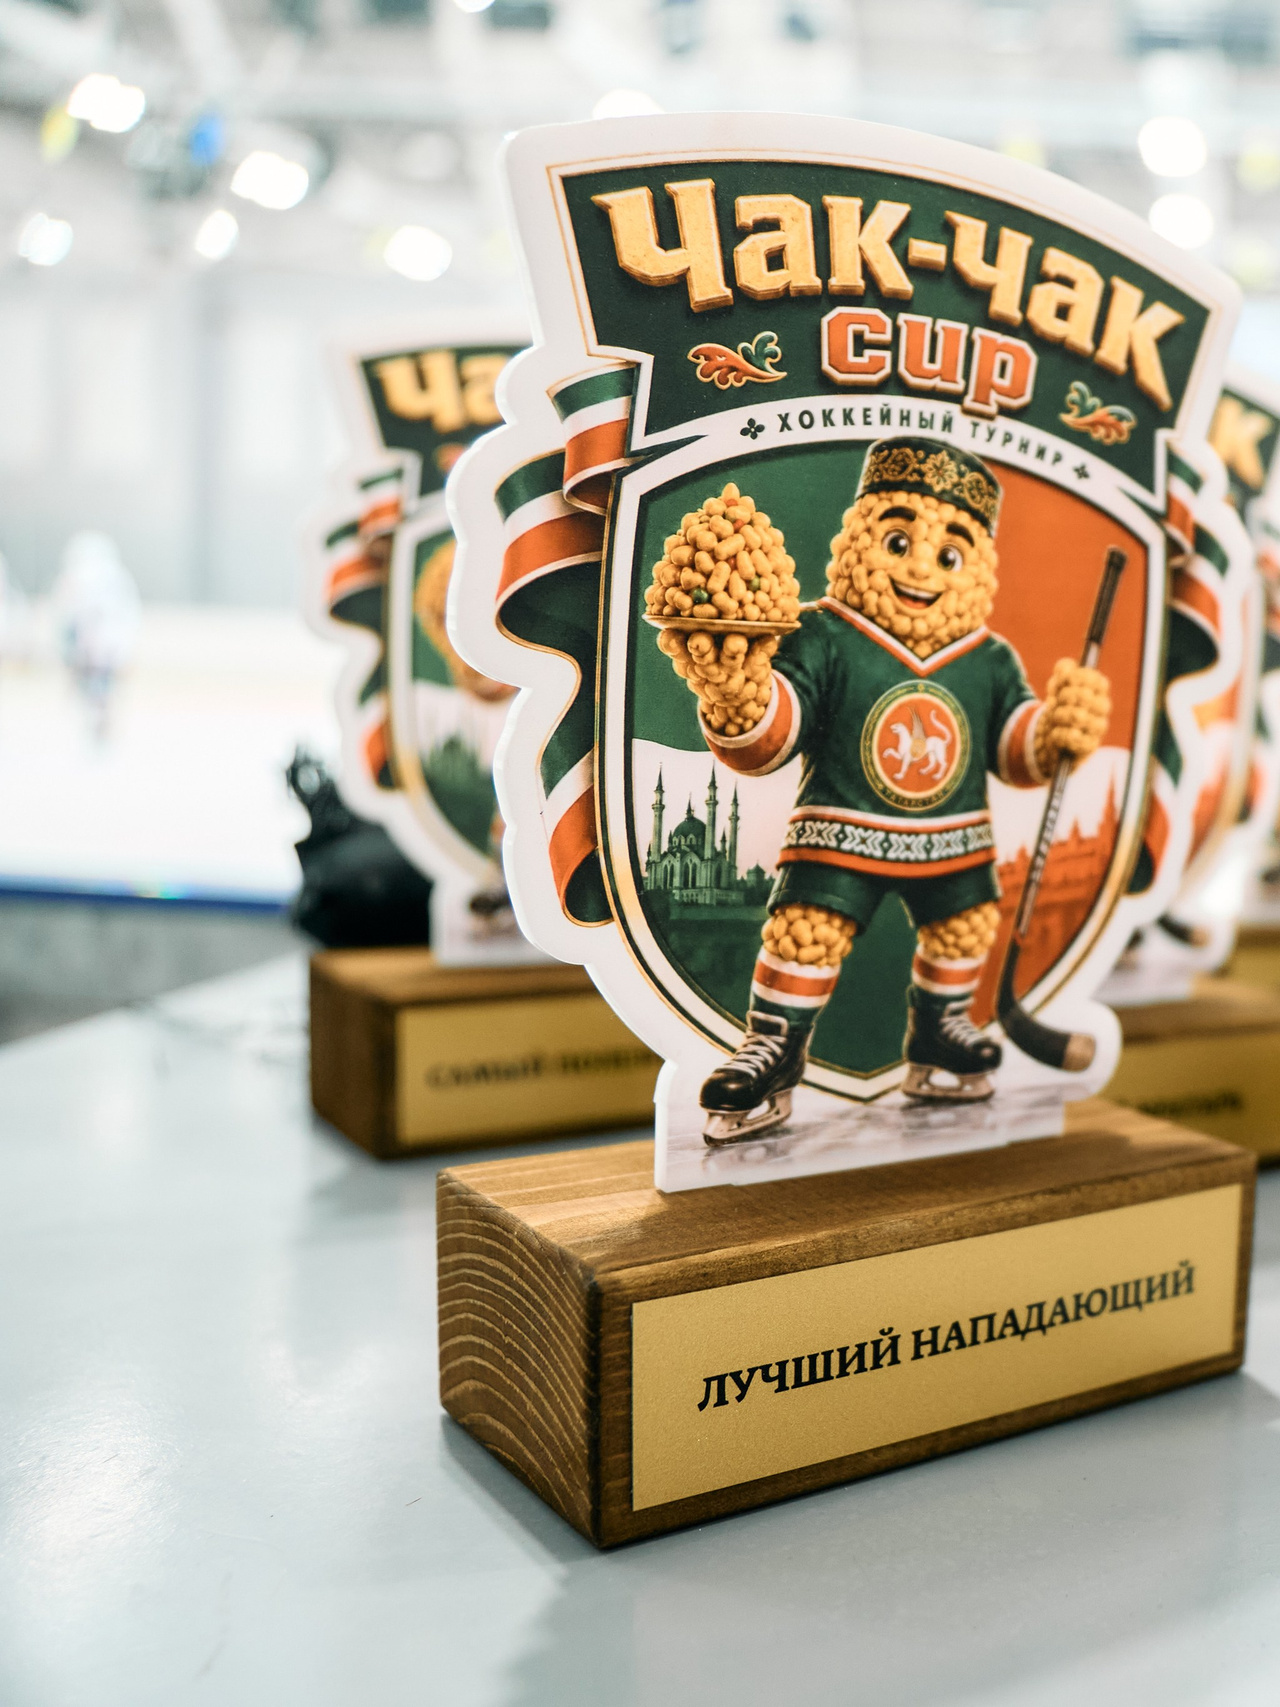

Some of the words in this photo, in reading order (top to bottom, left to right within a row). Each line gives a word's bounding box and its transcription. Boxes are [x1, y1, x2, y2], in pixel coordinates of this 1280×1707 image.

[777, 403, 954, 433] ХОККЕЙНЫЙ
[970, 421, 1064, 467] ТУРНИР
[697, 1327, 902, 1411] ЛУЧШИЙ
[911, 1260, 1195, 1361] НАПАДАЮЩИЙ
